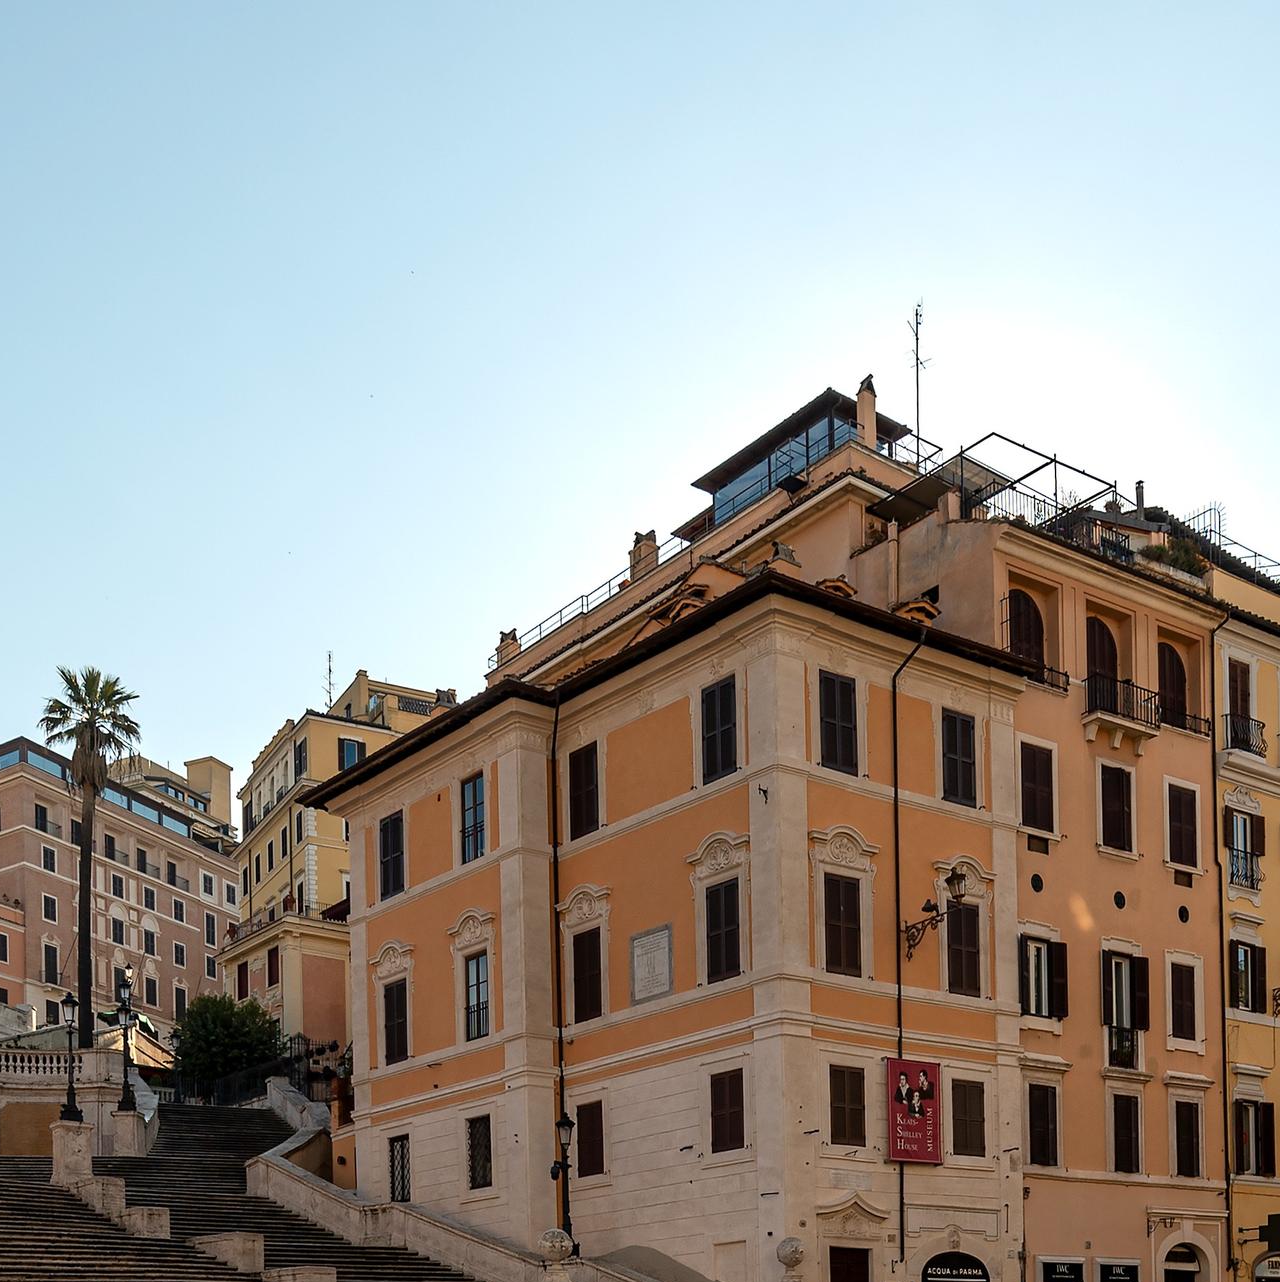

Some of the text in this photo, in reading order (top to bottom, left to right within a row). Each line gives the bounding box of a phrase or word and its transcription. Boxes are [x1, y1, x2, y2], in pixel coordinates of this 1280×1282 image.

[896, 1126, 922, 1138] SHELLEY
[926, 1107, 934, 1152] MUSEUM
[897, 1139, 918, 1152] HOUSE
[927, 1267, 951, 1275] ACQUA
[959, 1268, 983, 1276] PARMA
[1056, 1264, 1070, 1273] IWC
[1112, 1266, 1126, 1275] IWC
